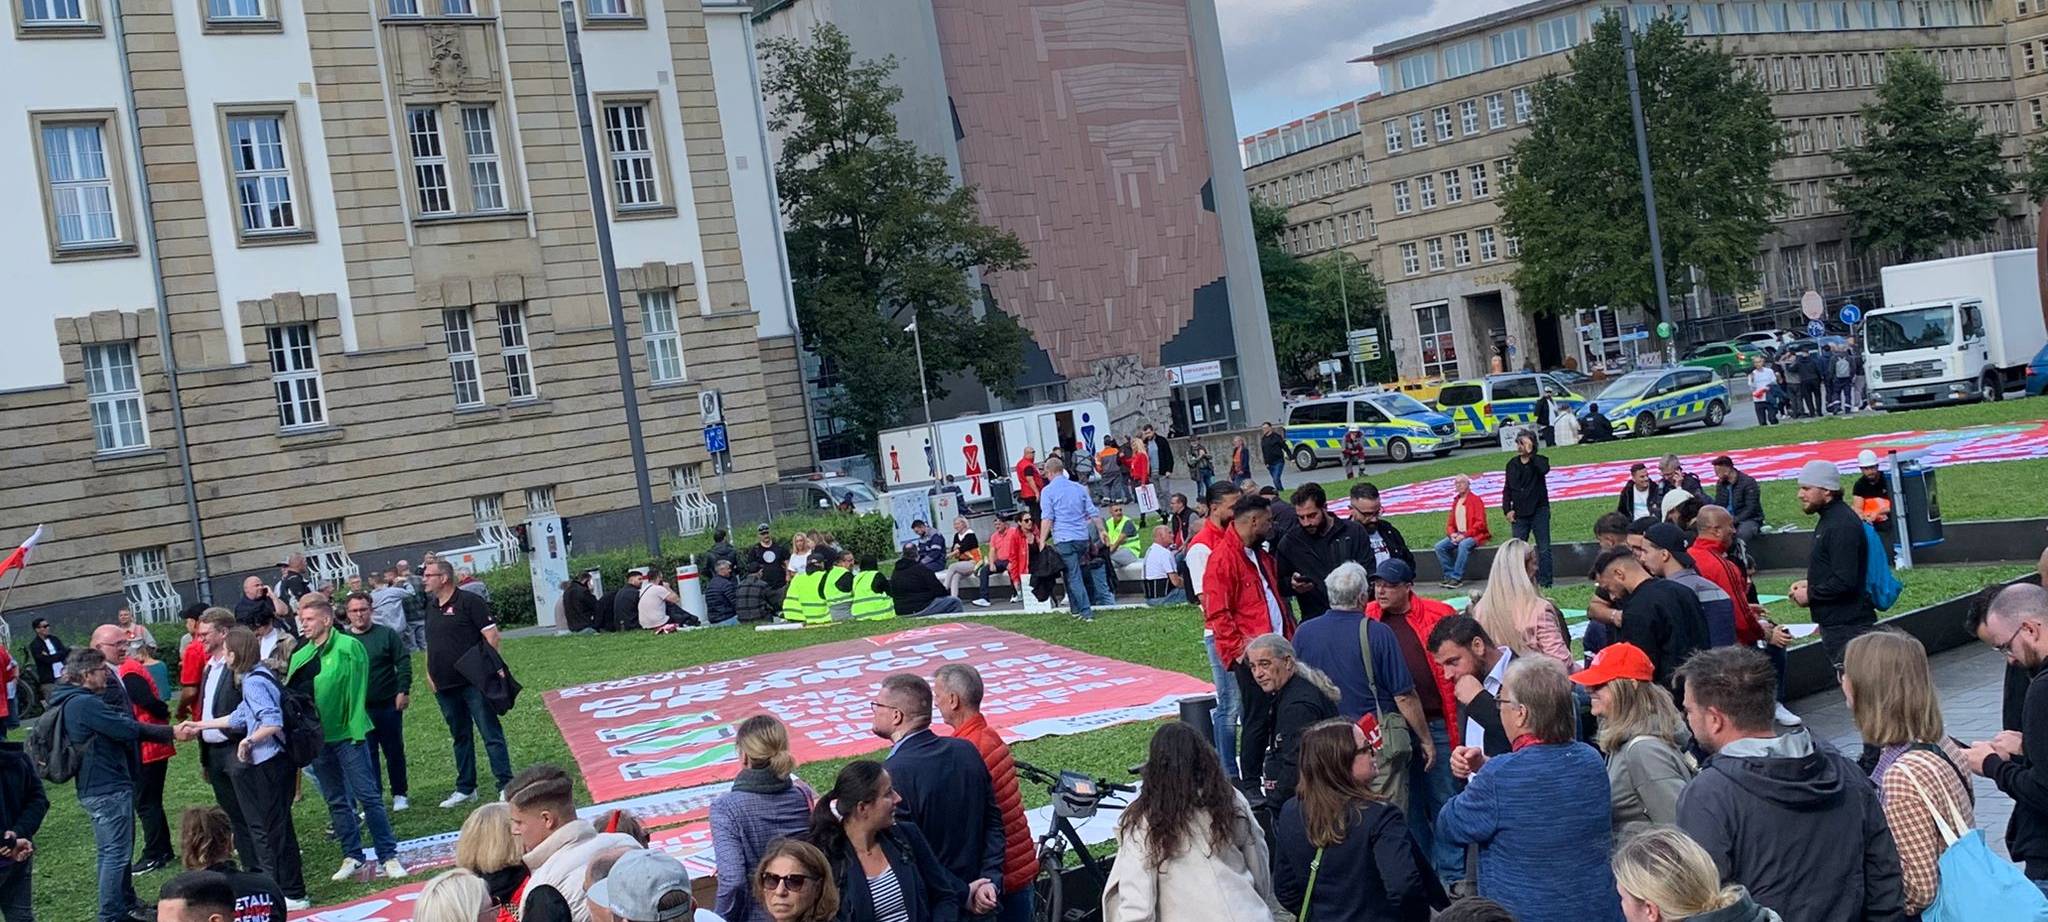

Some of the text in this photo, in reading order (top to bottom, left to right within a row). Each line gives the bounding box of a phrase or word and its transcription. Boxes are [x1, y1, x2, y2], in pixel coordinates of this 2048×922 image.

[546, 522, 553, 533] 6
[580, 678, 729, 712] DIE
[760, 640, 949, 682] ZEIT
